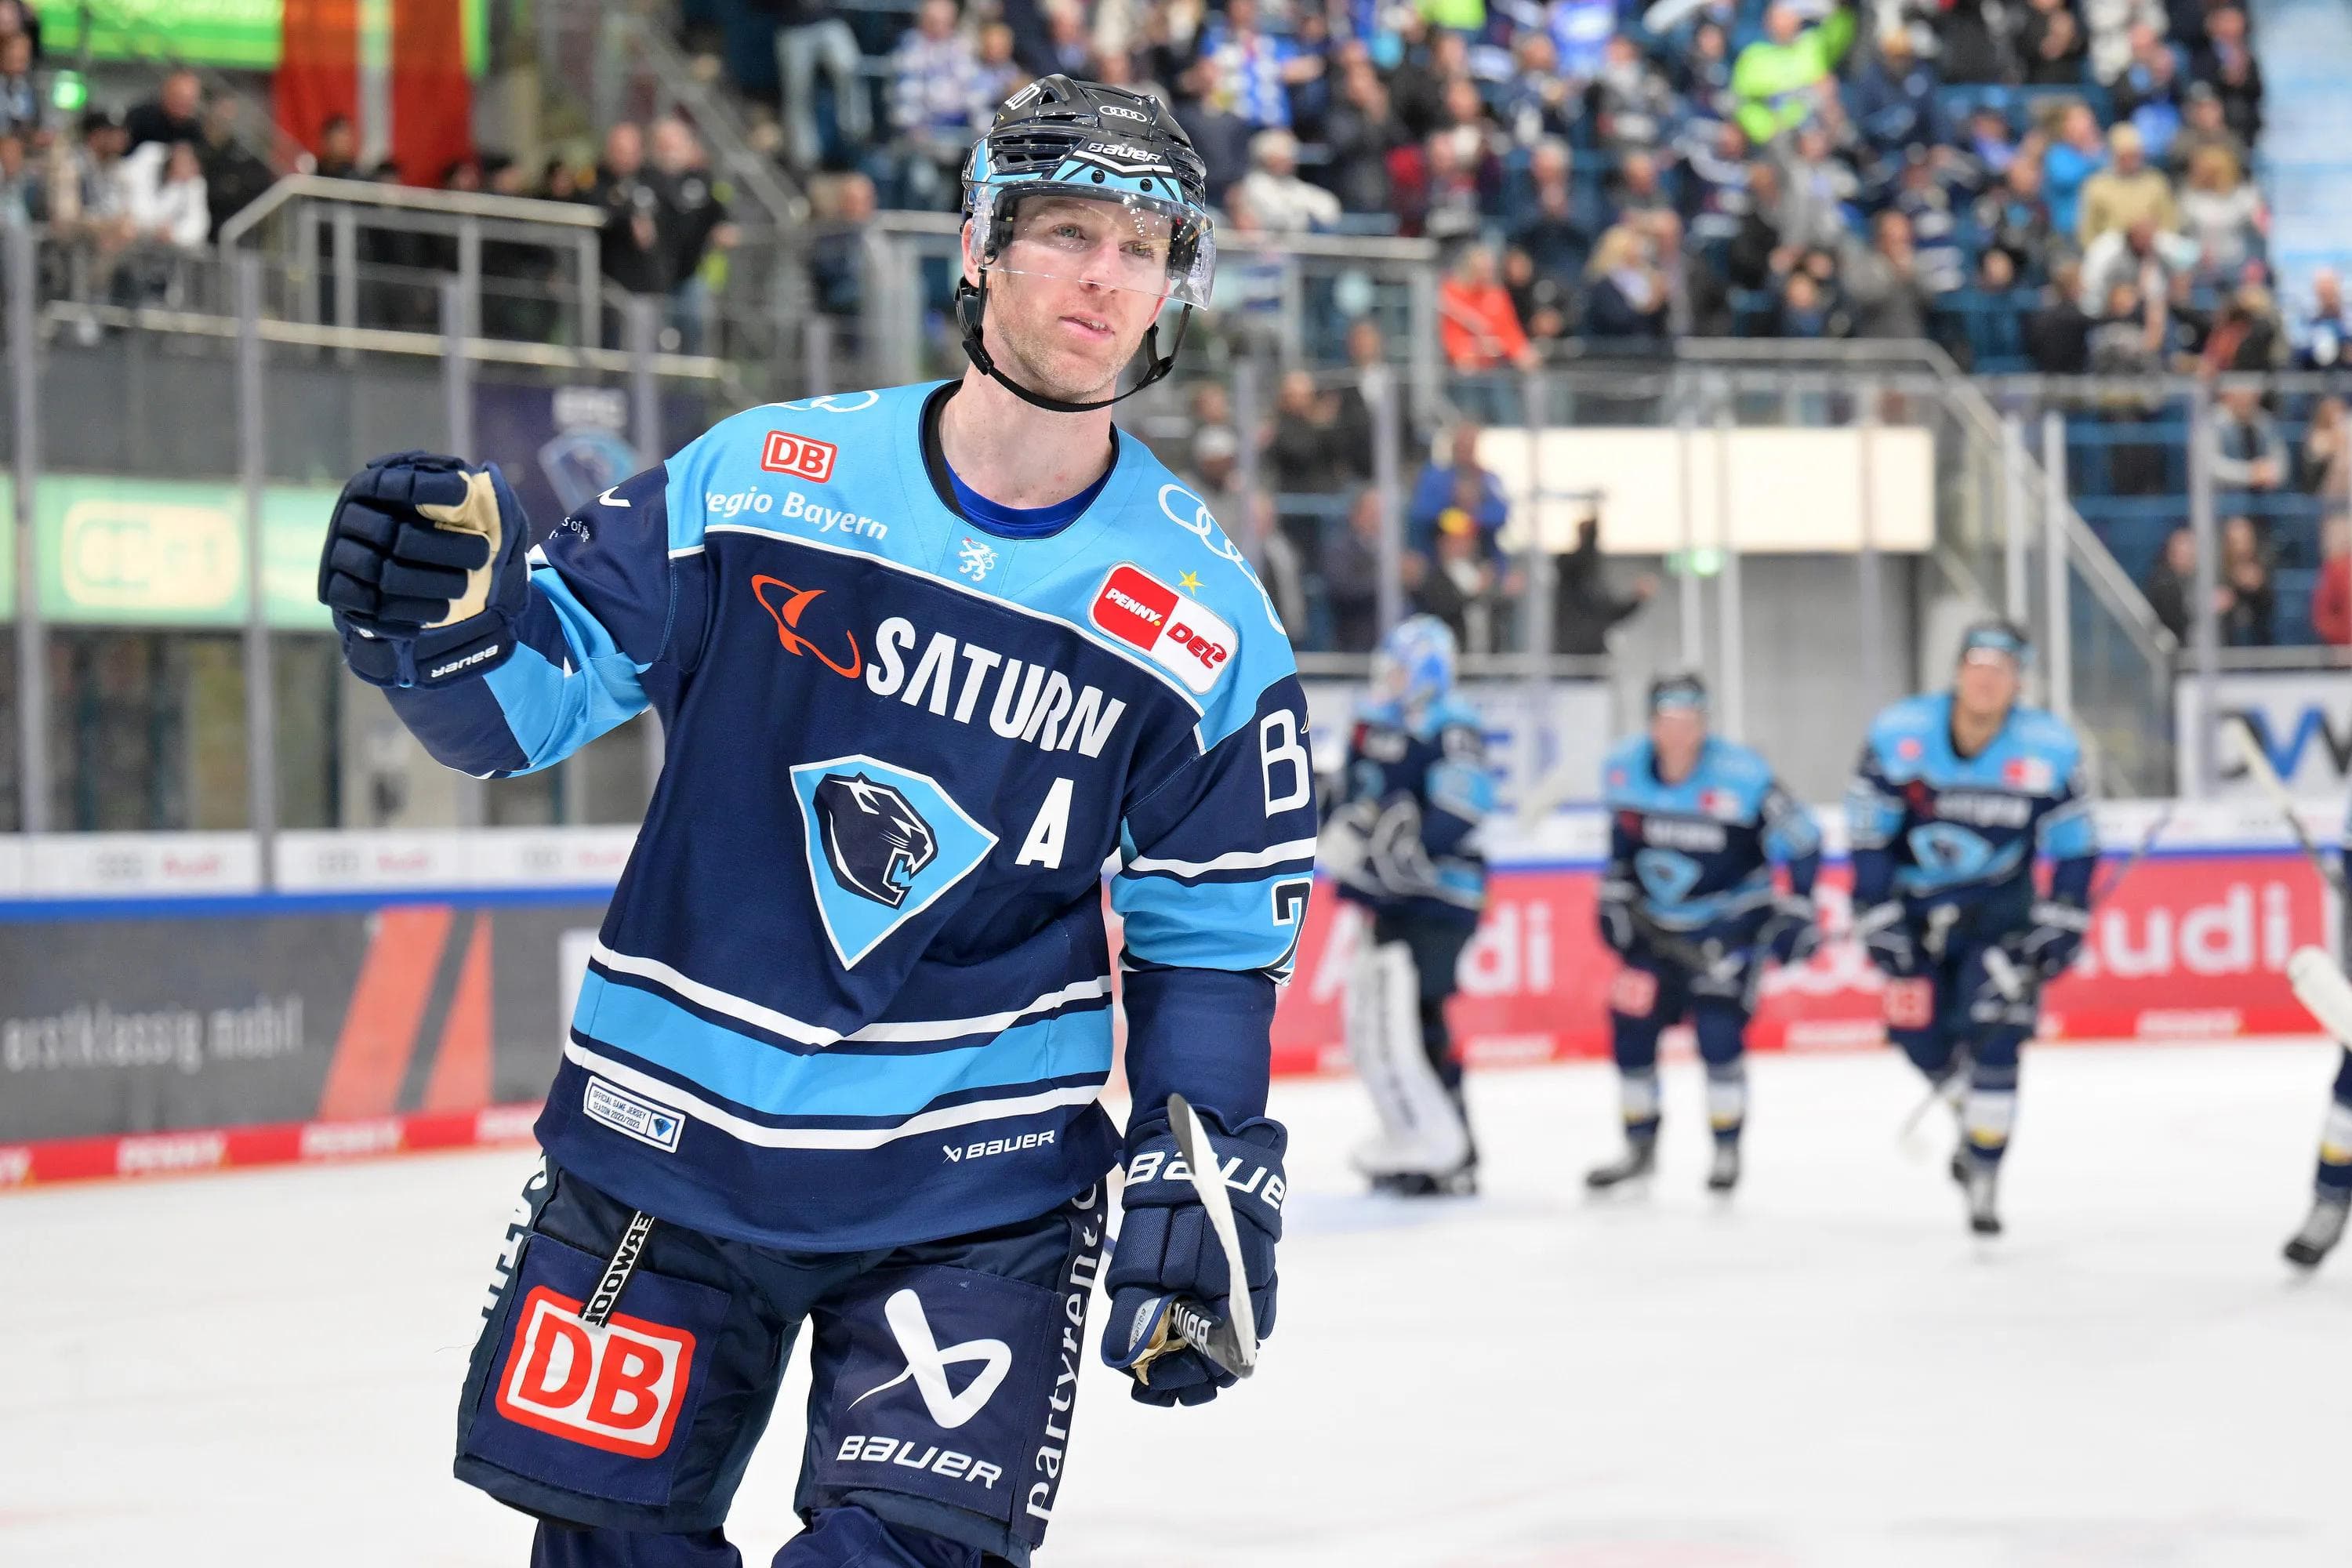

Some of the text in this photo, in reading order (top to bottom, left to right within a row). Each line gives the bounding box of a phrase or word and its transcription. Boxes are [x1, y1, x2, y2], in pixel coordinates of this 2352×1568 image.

[1087, 142, 1163, 164] BAUER
[706, 485, 889, 541] egio Bayern
[430, 644, 499, 678] BAUER
[866, 616, 1127, 758] SATURN
[1014, 777, 1074, 869] A
[1311, 902, 1554, 1000] Adi
[2072, 883, 2291, 978] udi
[965, 1128, 1056, 1160] BAUER
[836, 1435, 1003, 1490] BAUER
